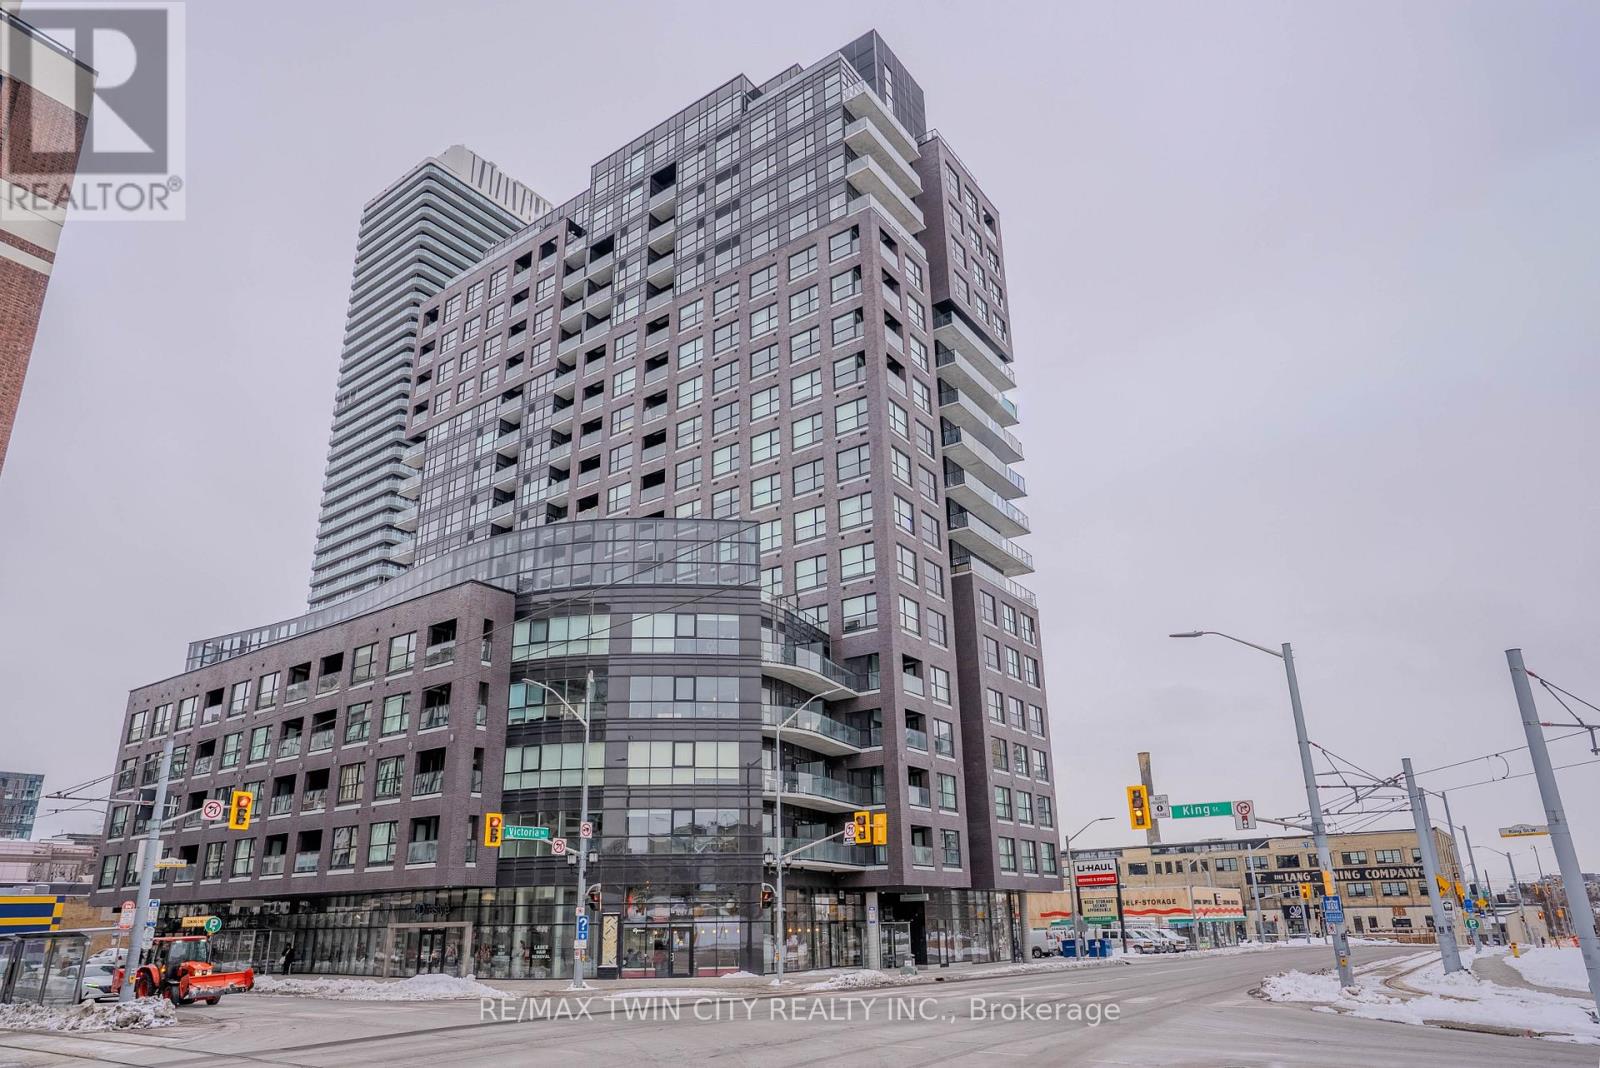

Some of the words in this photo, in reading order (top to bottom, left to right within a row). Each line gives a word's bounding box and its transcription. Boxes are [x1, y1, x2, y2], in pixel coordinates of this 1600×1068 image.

[1183, 804, 1211, 818] King
[508, 827, 540, 838] Victoria
[1077, 863, 1113, 872] U-HAUL
[1284, 871, 1311, 883] LANG
[1365, 867, 1421, 880] COMPANY
